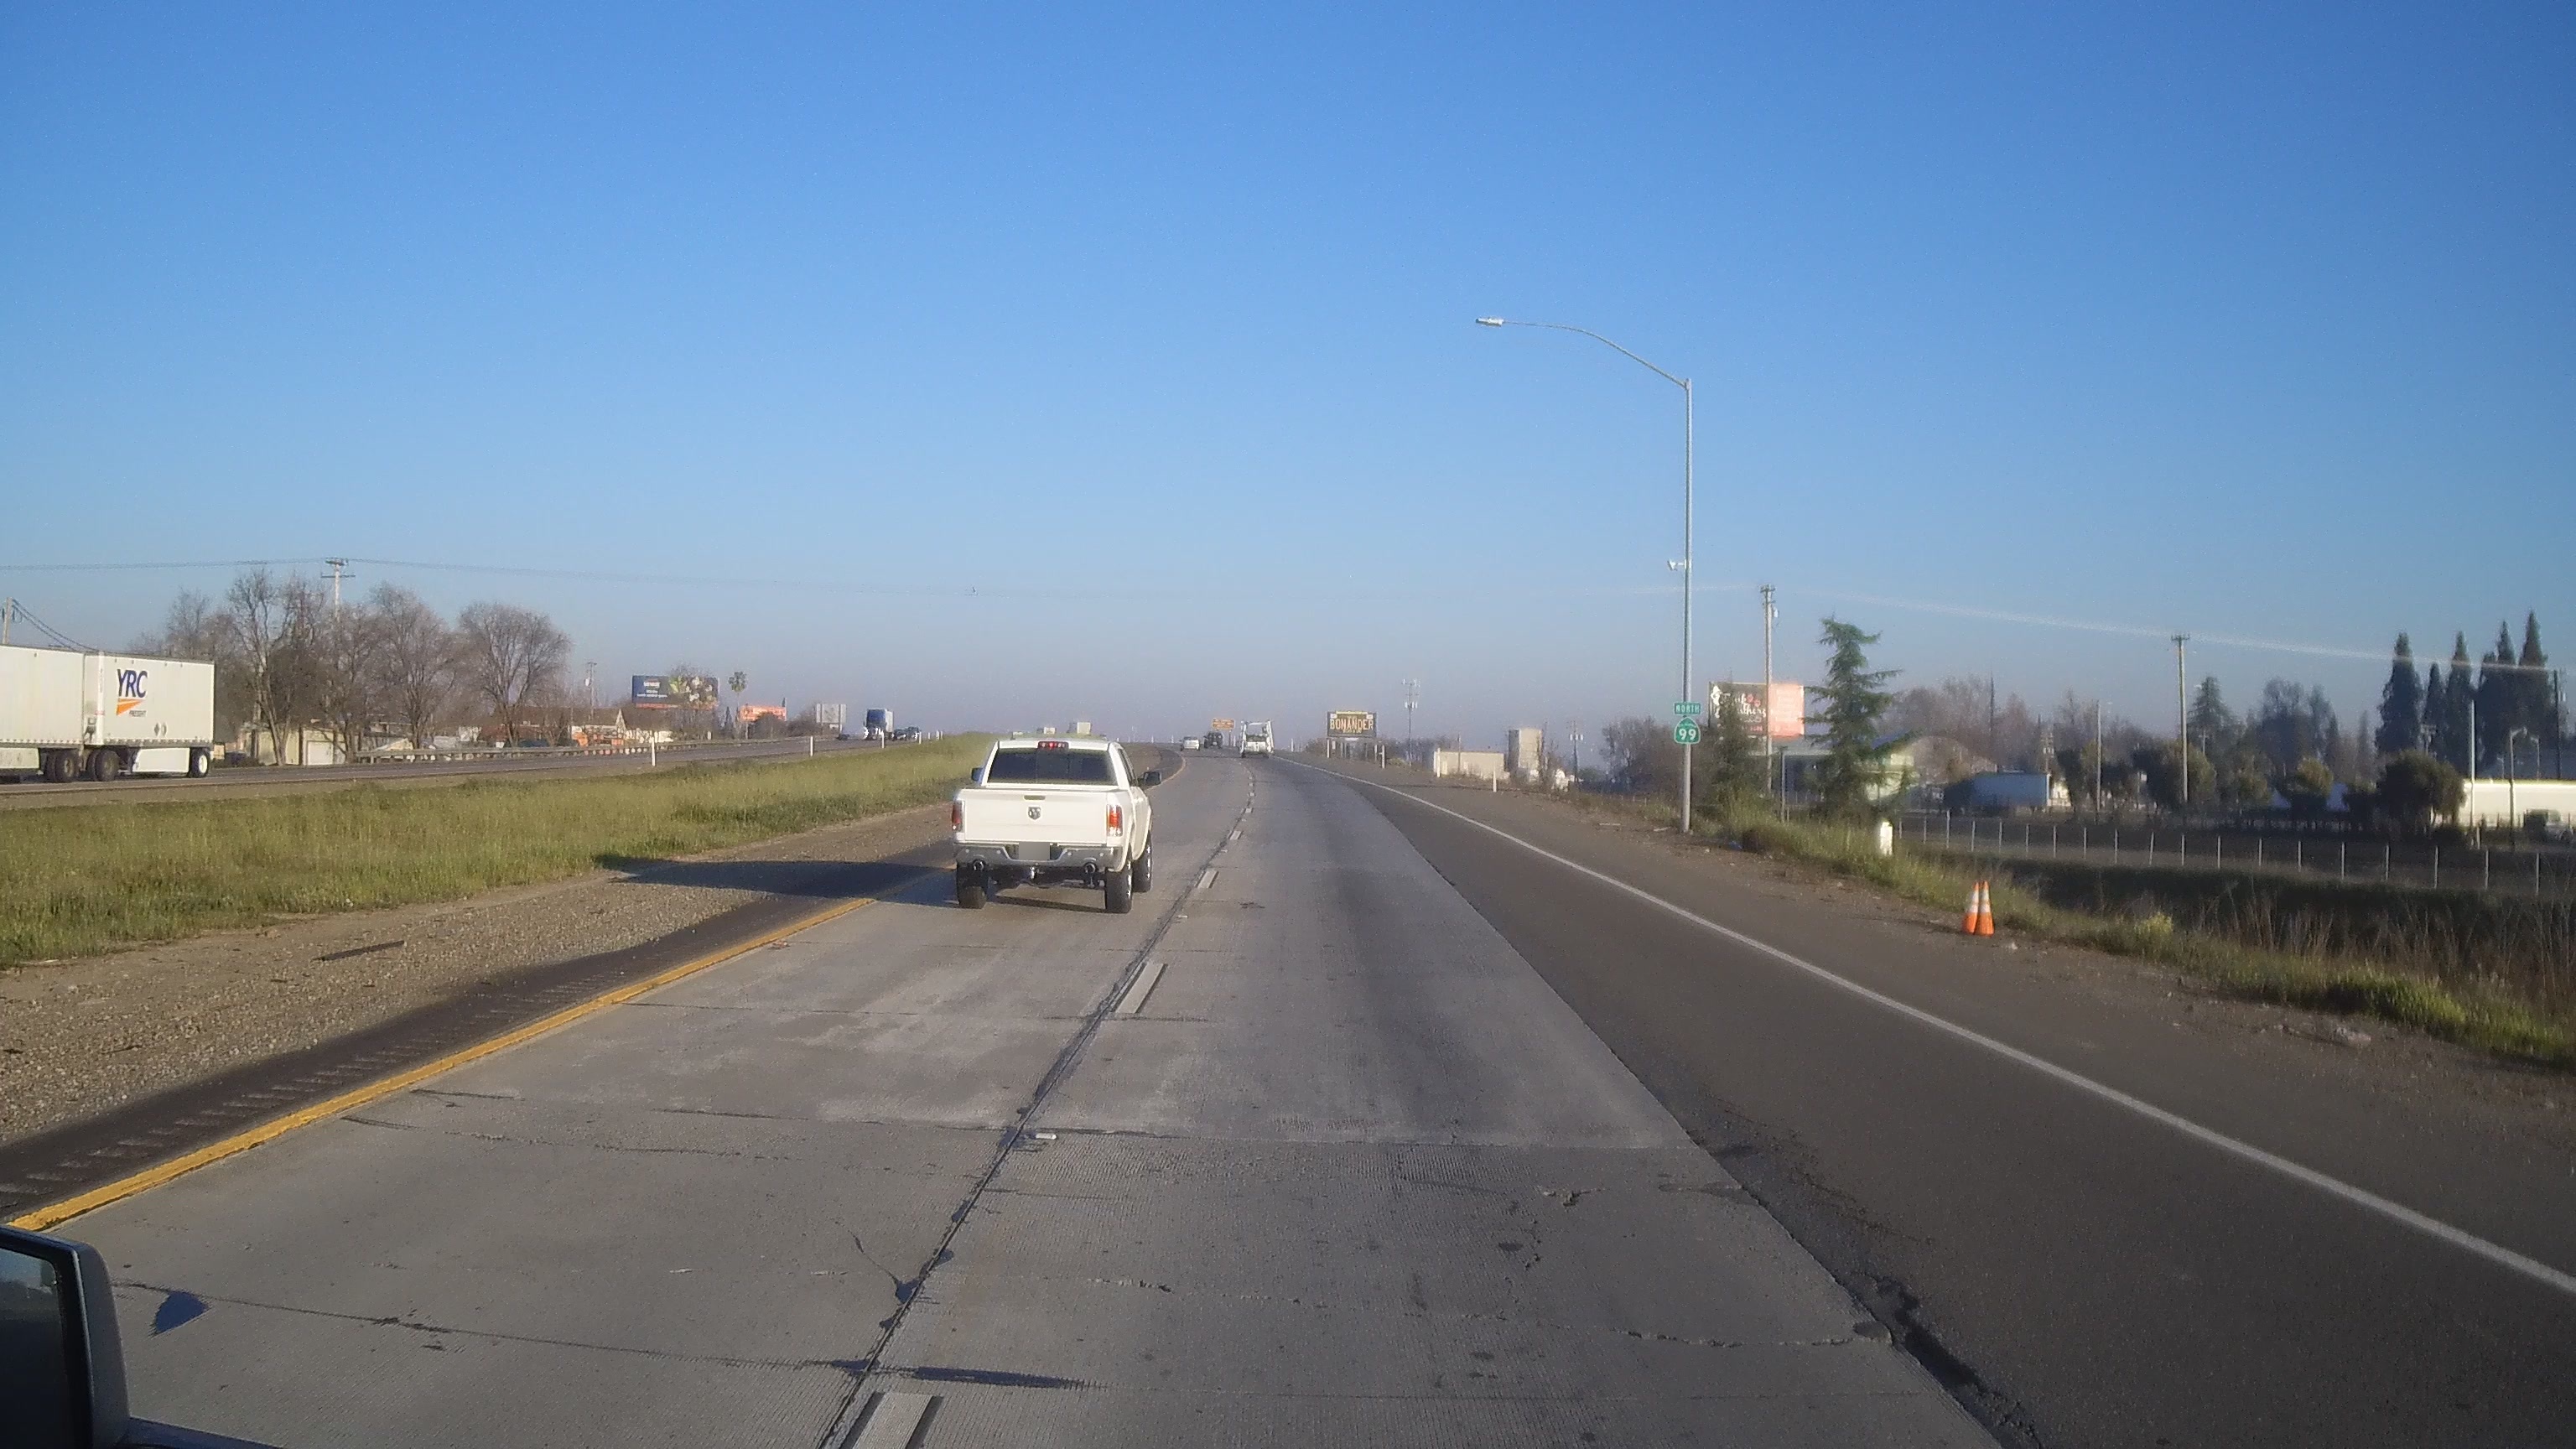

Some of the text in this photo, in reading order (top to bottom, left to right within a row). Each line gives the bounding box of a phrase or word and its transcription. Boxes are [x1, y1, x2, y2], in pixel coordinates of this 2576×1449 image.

[117, 669, 148, 698] YRC
[1675, 704, 1700, 713] NORTH
[1329, 718, 1374, 730] BONANDER
[1679, 728, 1696, 740] 99
